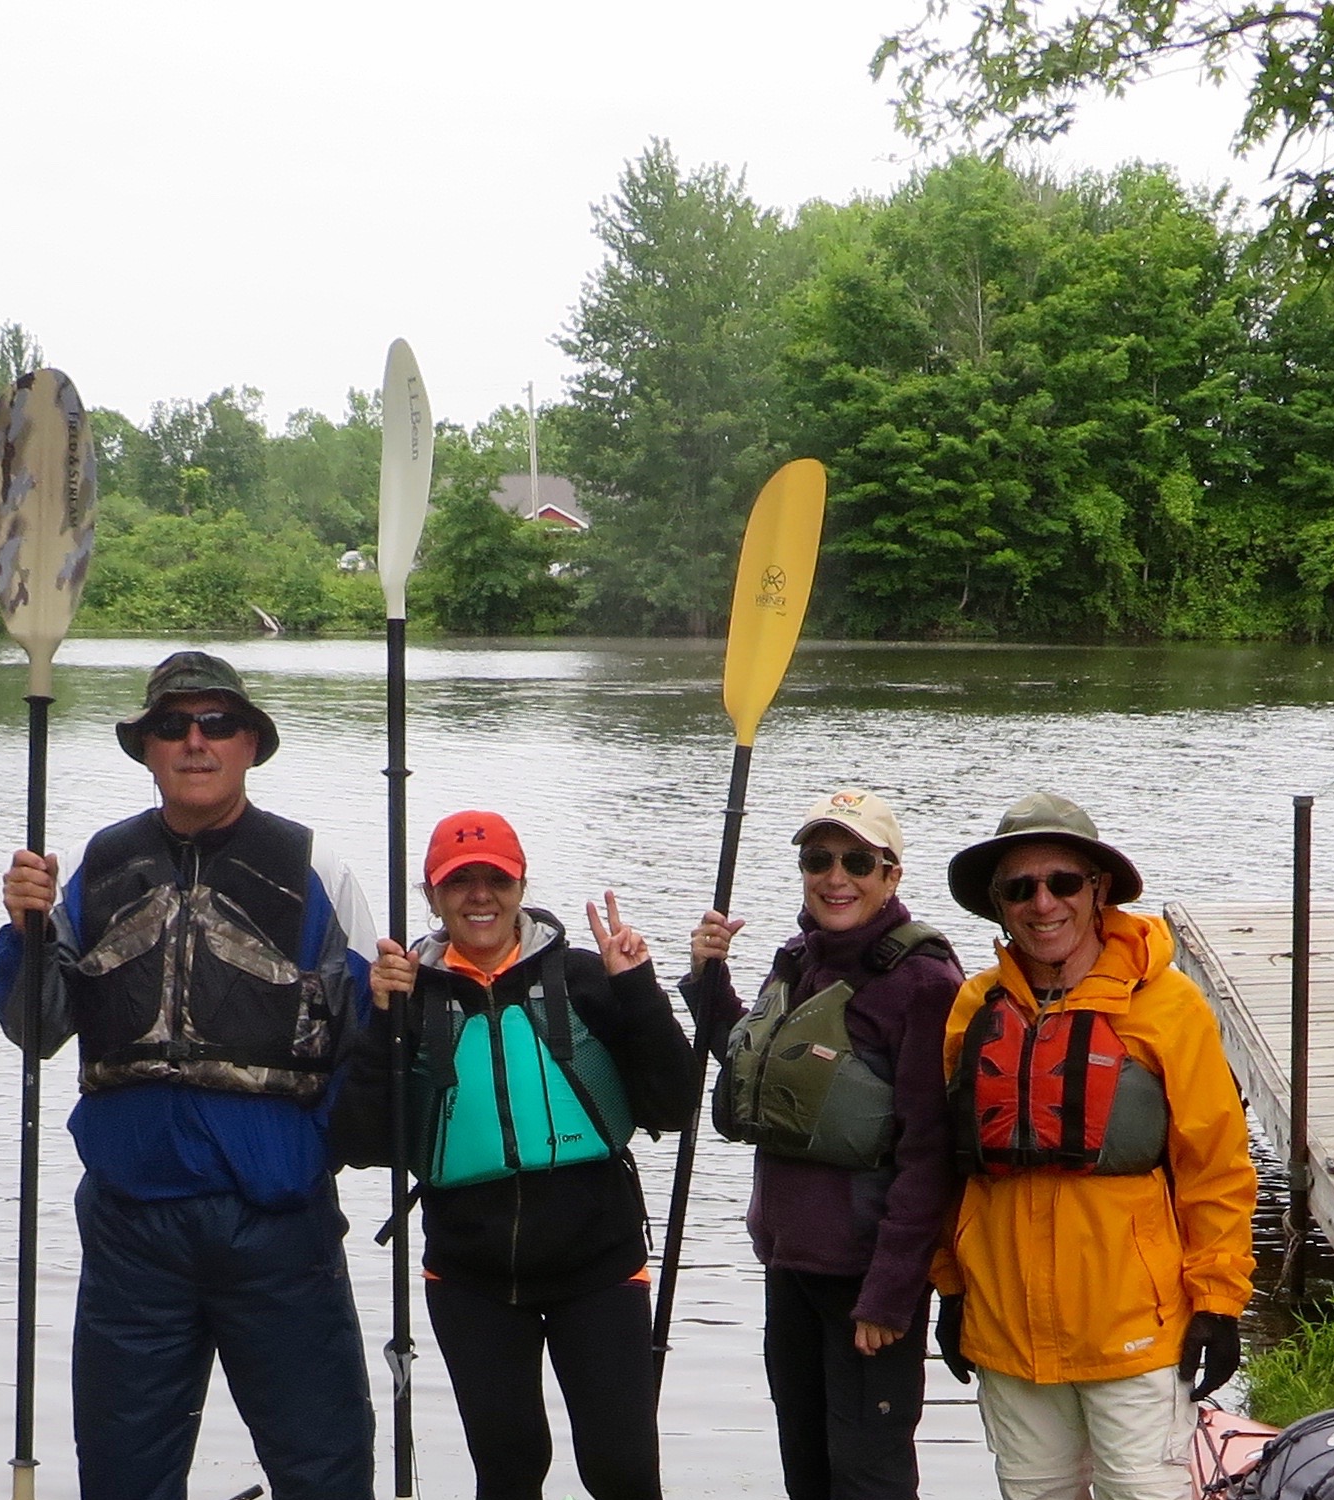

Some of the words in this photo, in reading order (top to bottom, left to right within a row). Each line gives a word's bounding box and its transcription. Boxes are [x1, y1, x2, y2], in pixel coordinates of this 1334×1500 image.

[67, 411, 79, 453] FIELD
[67, 455, 79, 468] &
[67, 470, 79, 529] STREAM
